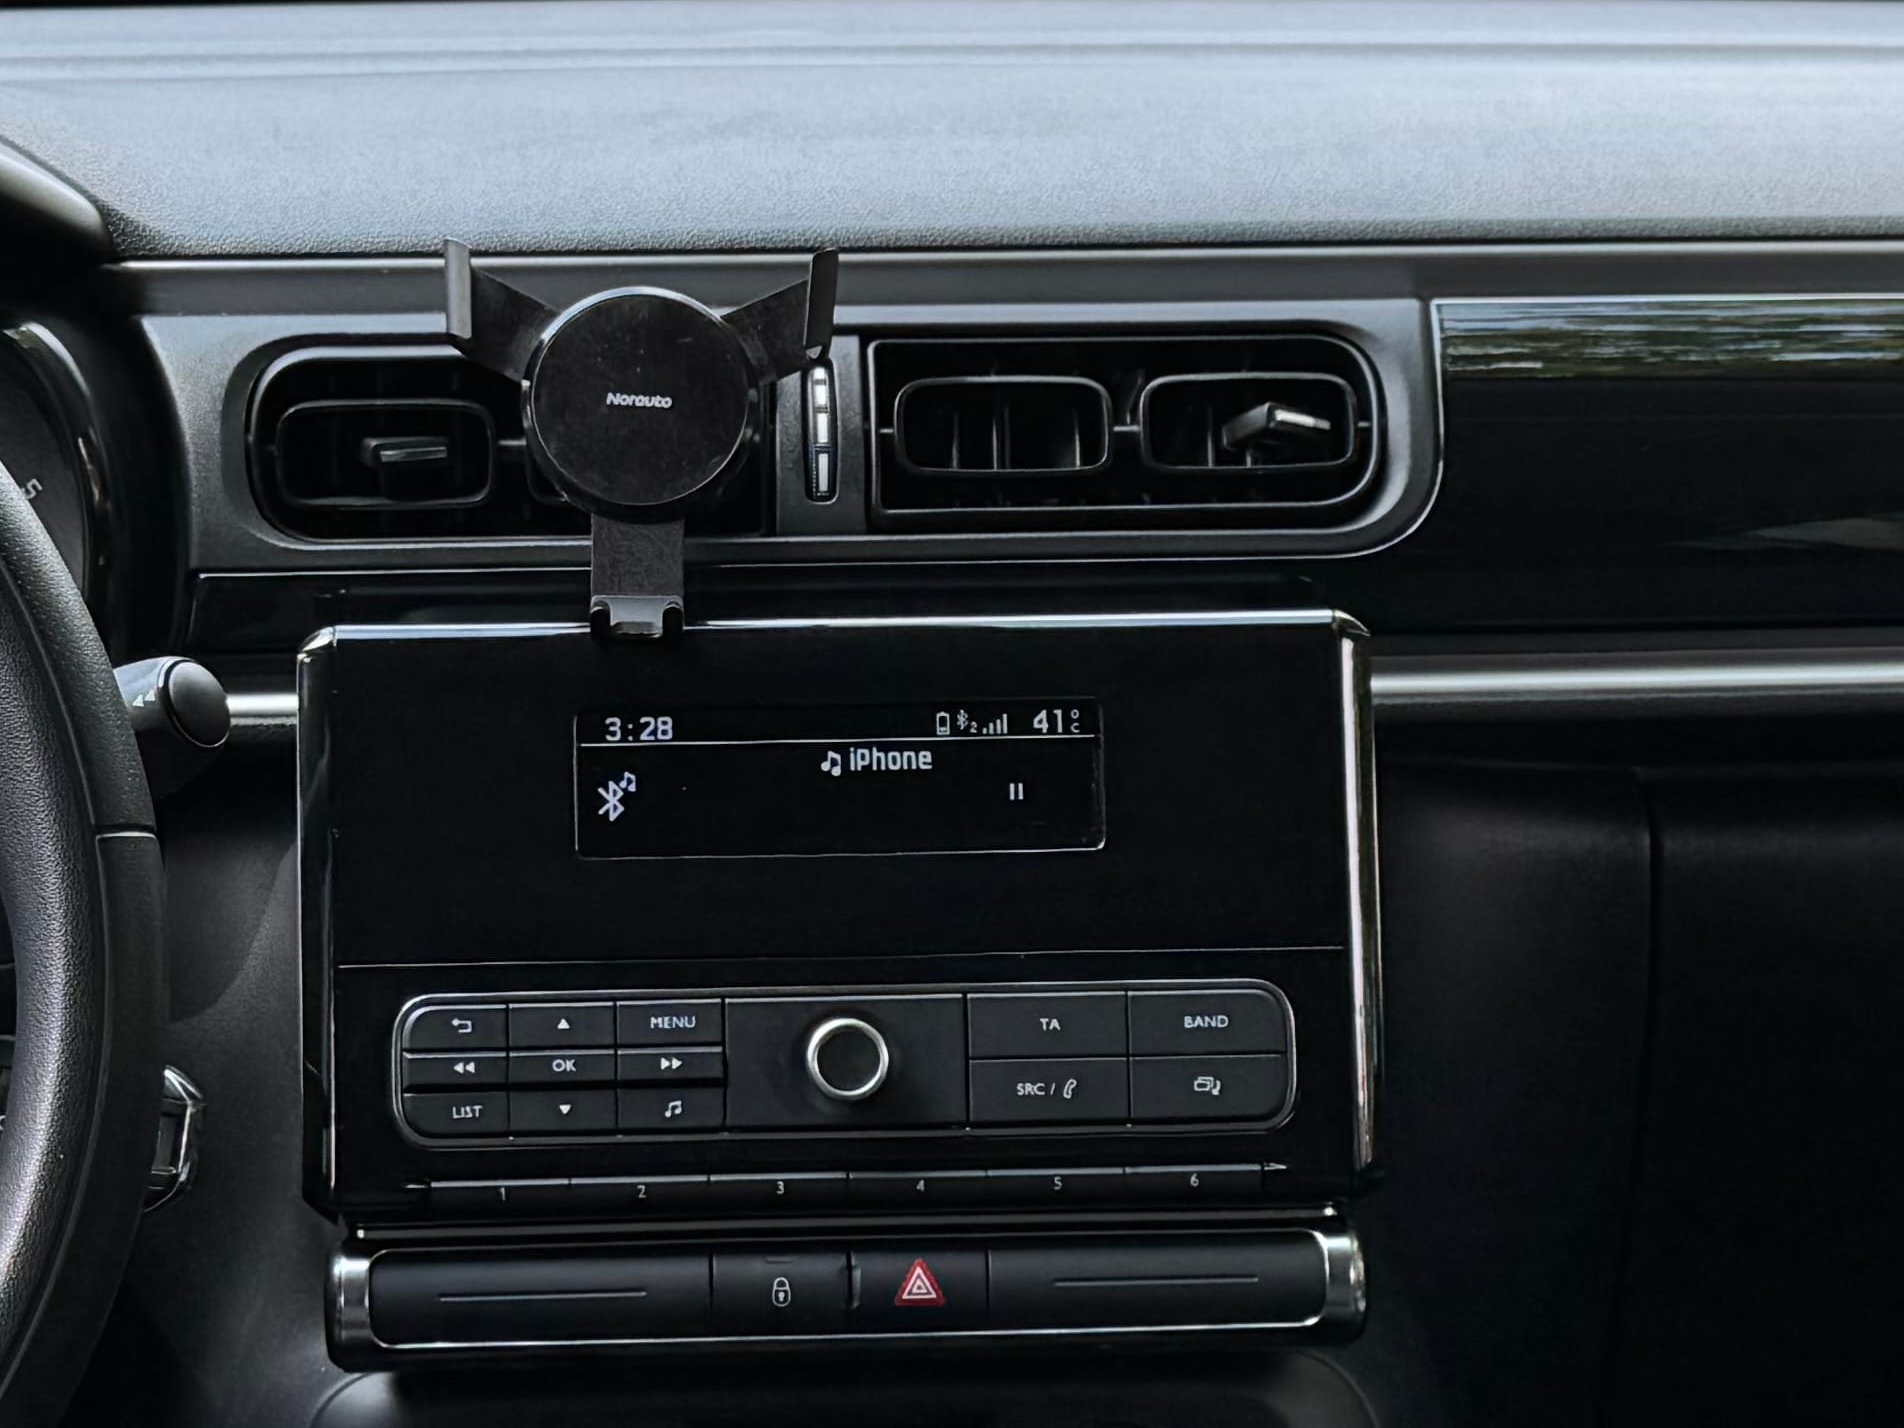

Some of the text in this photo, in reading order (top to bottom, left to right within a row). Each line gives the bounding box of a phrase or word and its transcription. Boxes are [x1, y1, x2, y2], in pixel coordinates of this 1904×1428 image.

[606, 391, 673, 409] Norauto
[604, 716, 673, 741] 3:28
[849, 747, 933, 772] iPhone
[650, 1015, 696, 1030] MENU
[1039, 1018, 1061, 1031] TA
[1184, 1014, 1229, 1029] BAND
[552, 1059, 576, 1072] OK
[1016, 1082, 1045, 1097] SRC
[452, 1104, 483, 1119] LIST
